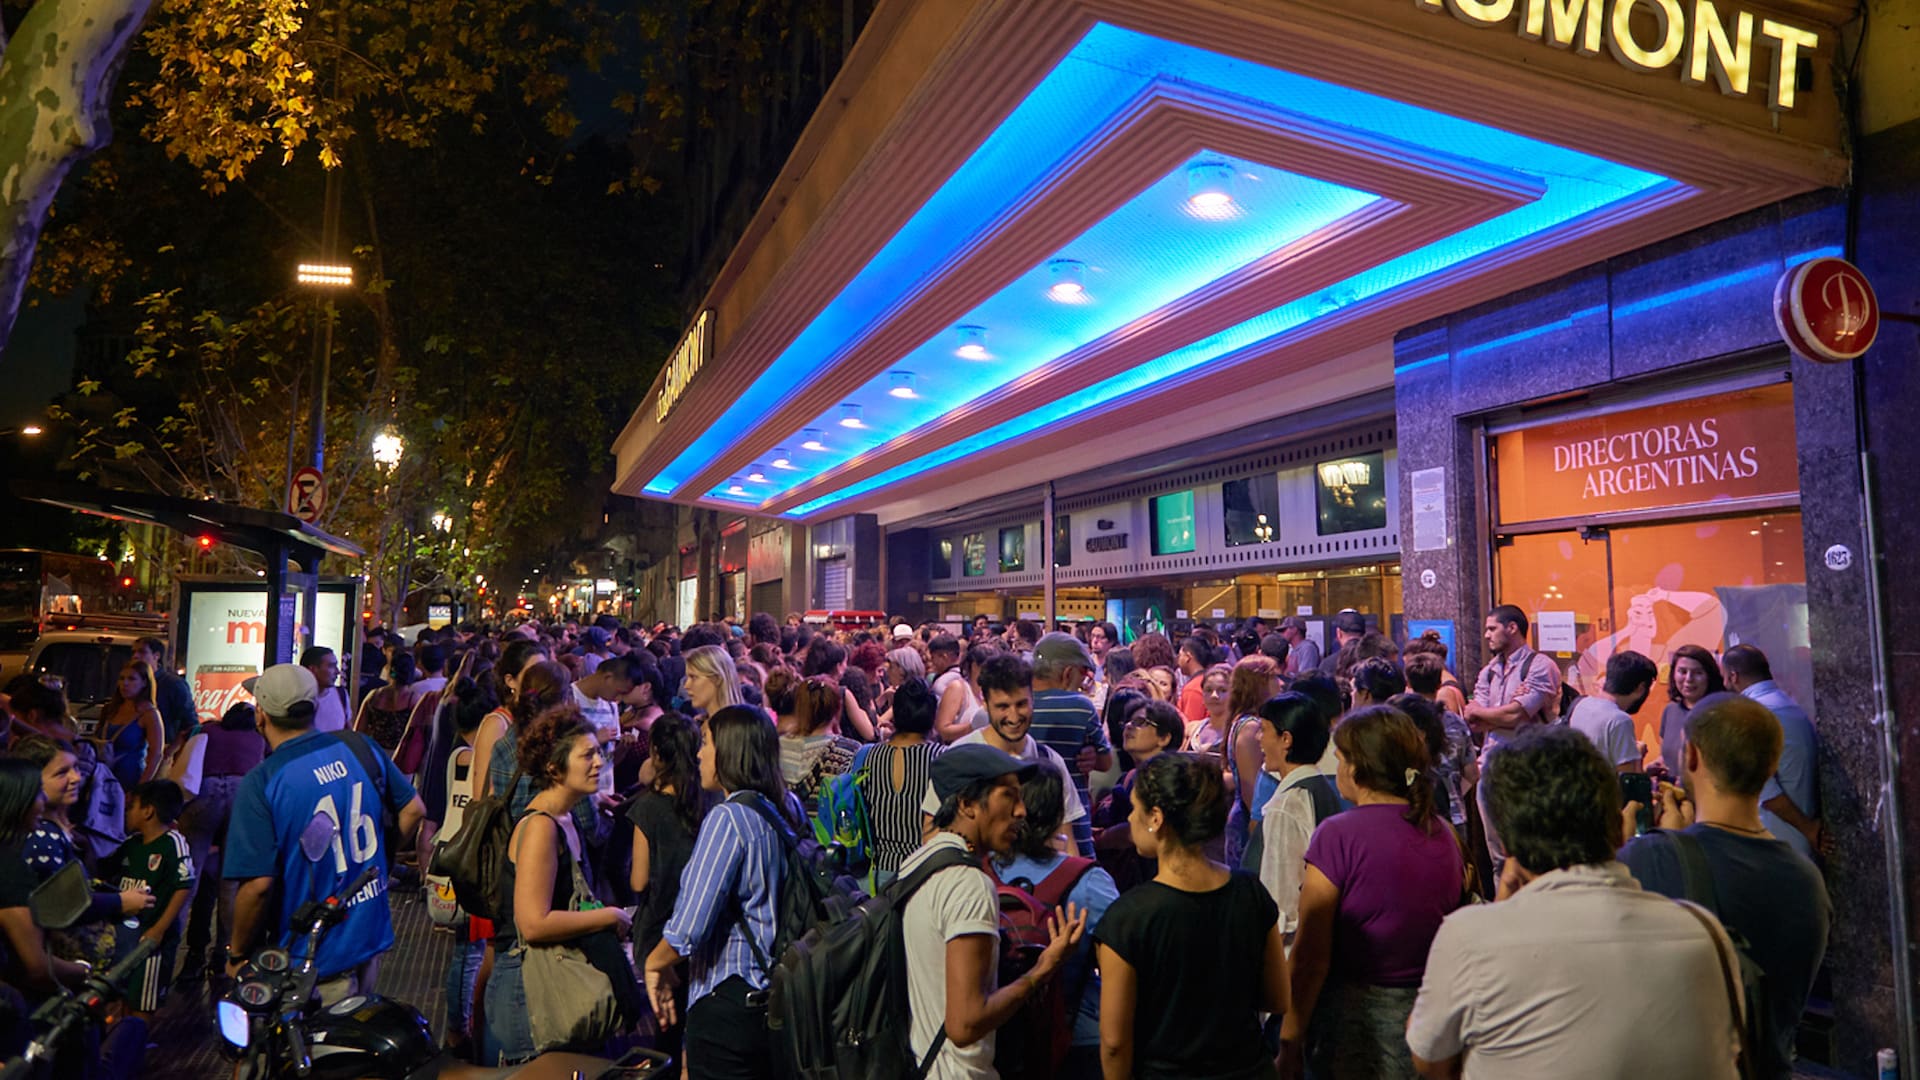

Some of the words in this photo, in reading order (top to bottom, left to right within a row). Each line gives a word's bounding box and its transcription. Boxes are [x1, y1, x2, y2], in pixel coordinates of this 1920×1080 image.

[1553, 418, 1719, 472] DIRECTORAS
[1582, 446, 1759, 499] ARGENTINAS
[313, 760, 348, 785] NIKO
[313, 782, 378, 874] 16
